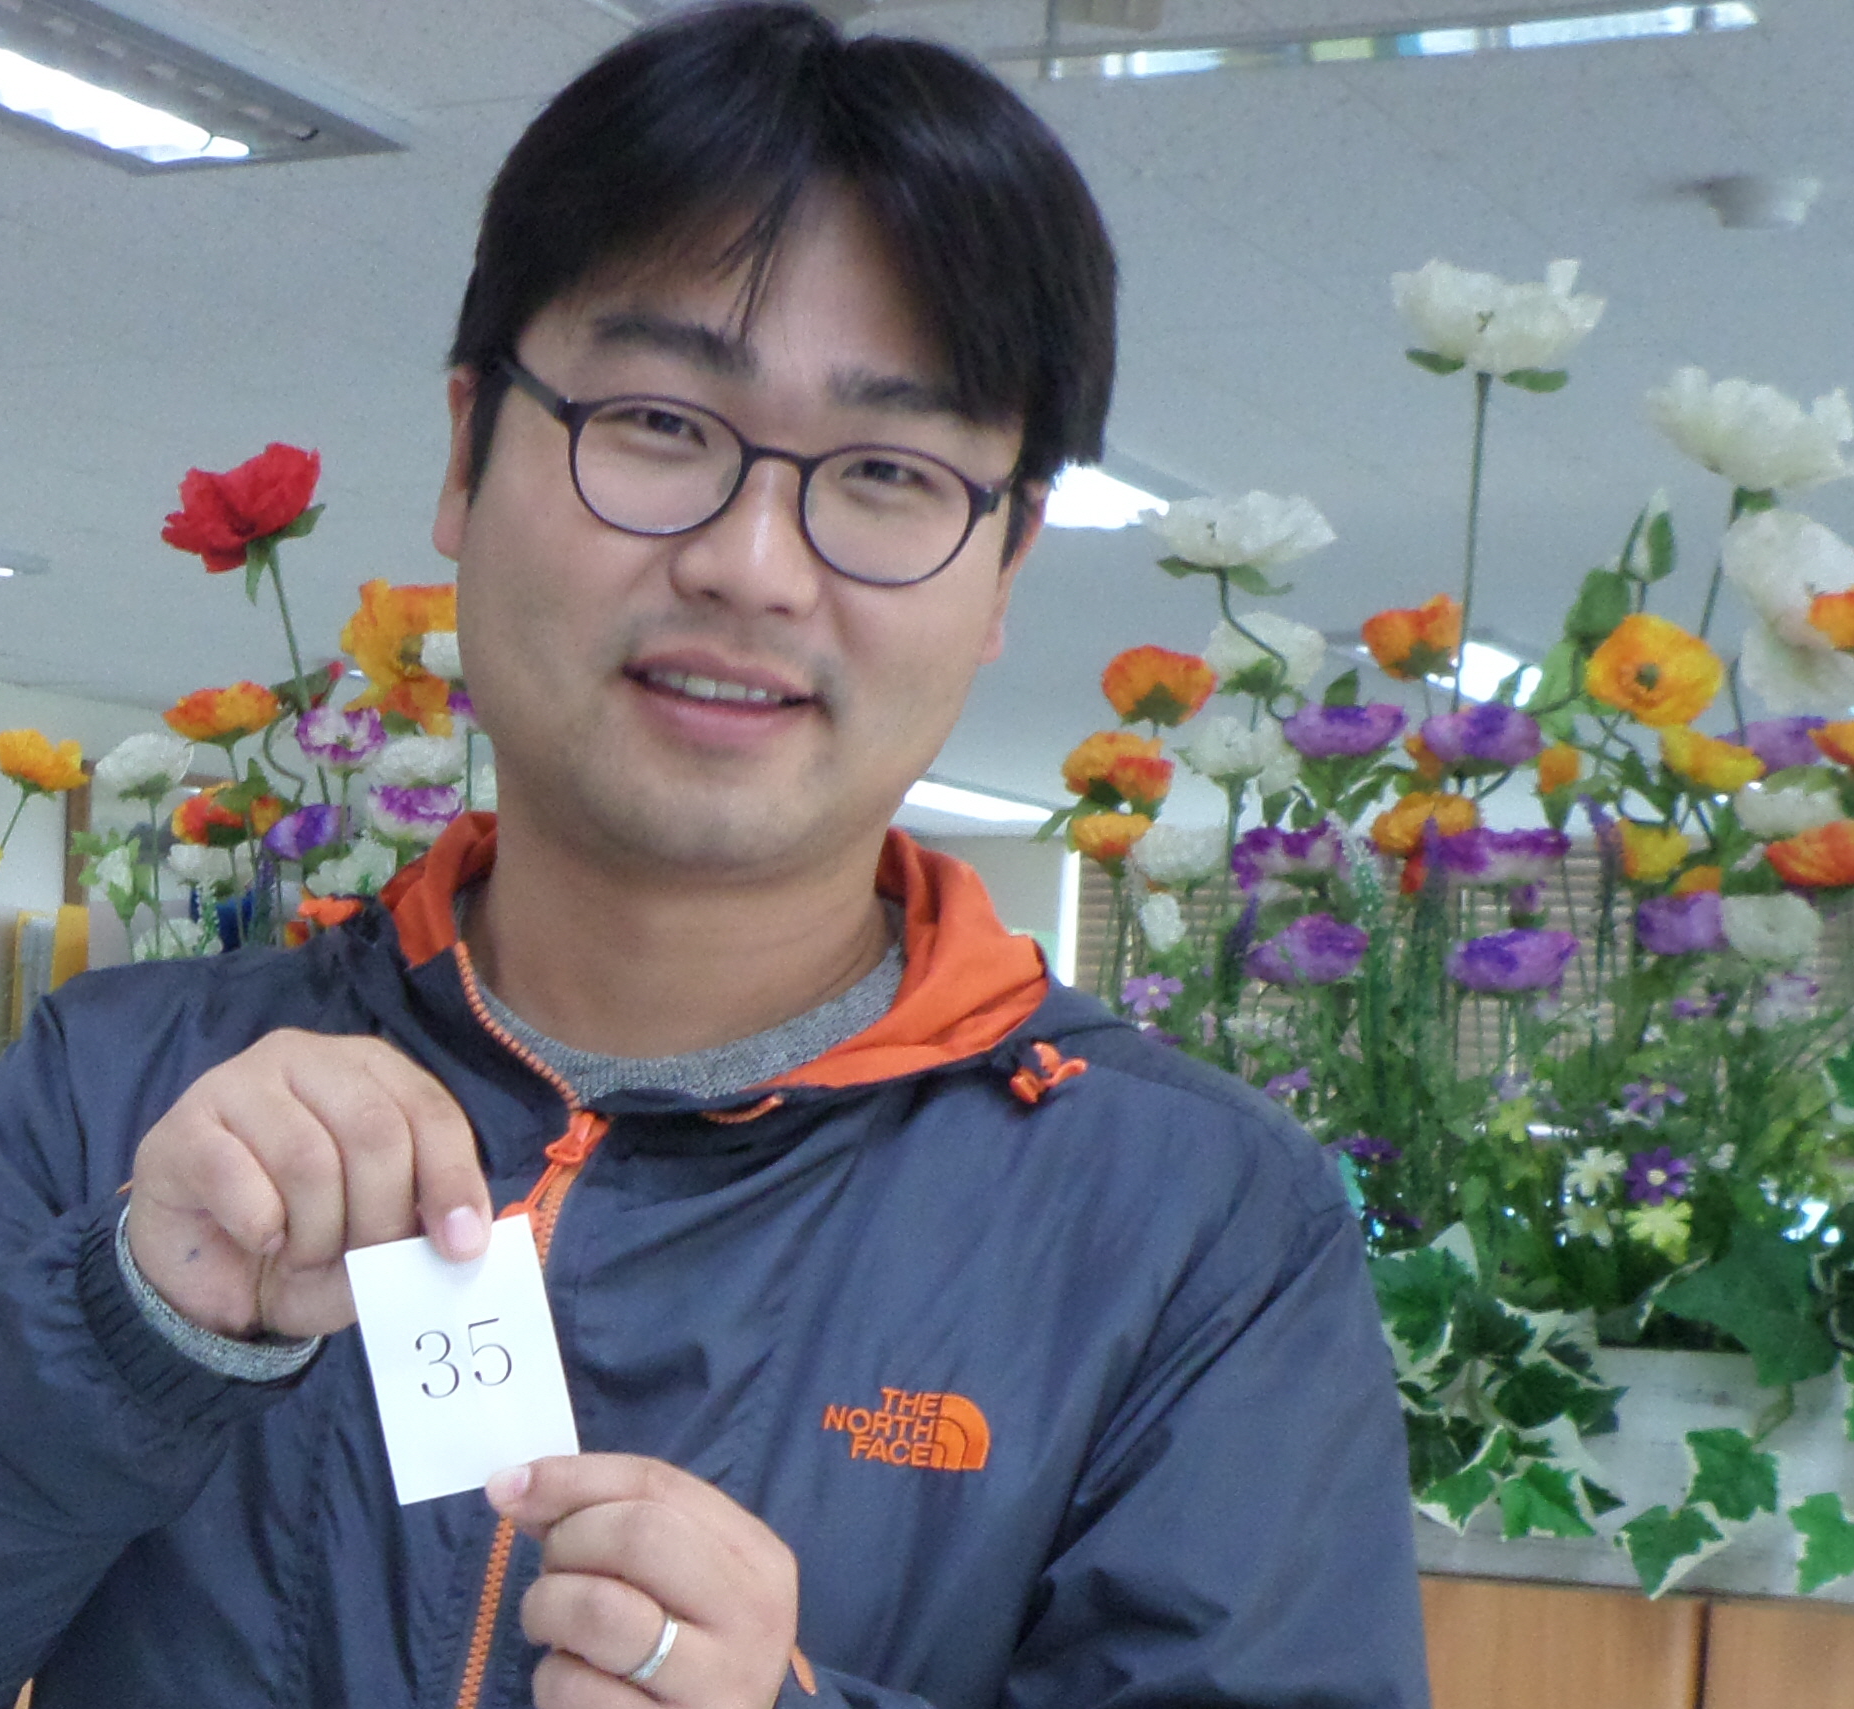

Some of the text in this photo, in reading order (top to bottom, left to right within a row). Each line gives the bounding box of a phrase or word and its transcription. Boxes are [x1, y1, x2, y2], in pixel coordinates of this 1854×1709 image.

[414, 1317, 513, 1399] 35
[880, 1386, 942, 1417] THE
[821, 1403, 936, 1442] NORTH
[850, 1435, 932, 1467] FACE
